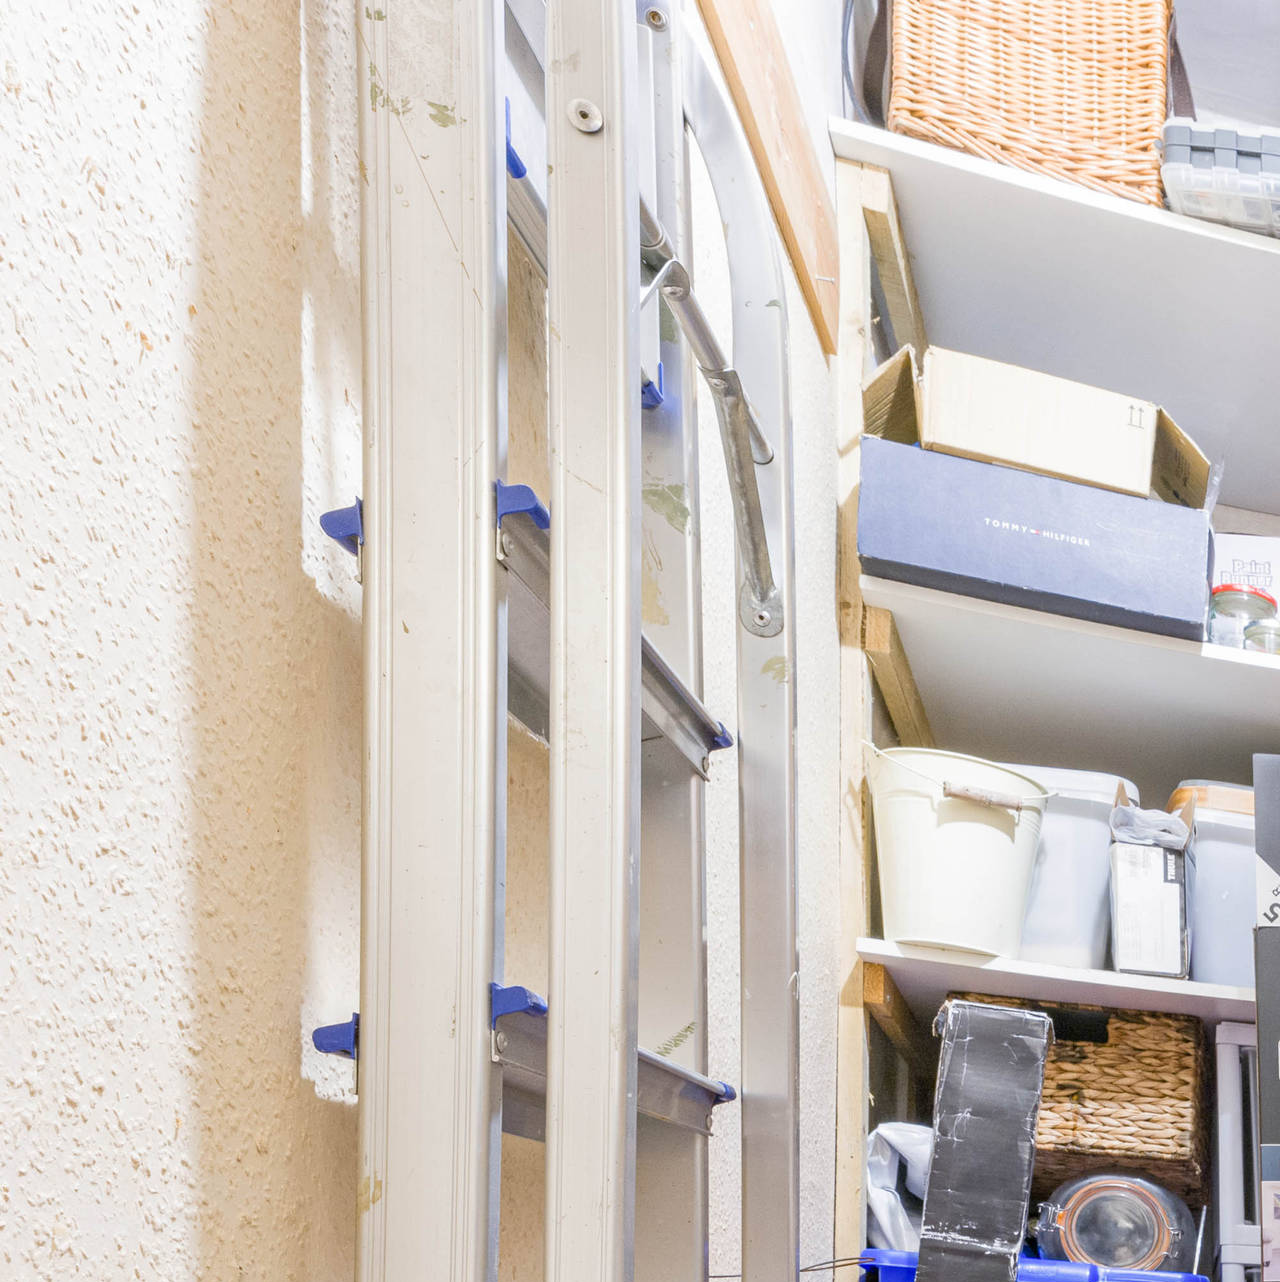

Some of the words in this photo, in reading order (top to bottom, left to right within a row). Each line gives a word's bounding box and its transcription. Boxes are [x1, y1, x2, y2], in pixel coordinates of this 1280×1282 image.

[985, 517, 1028, 533] TOMMY
[1042, 530, 1091, 551] HILFIGER
[1231, 558, 1272, 576] Paint
